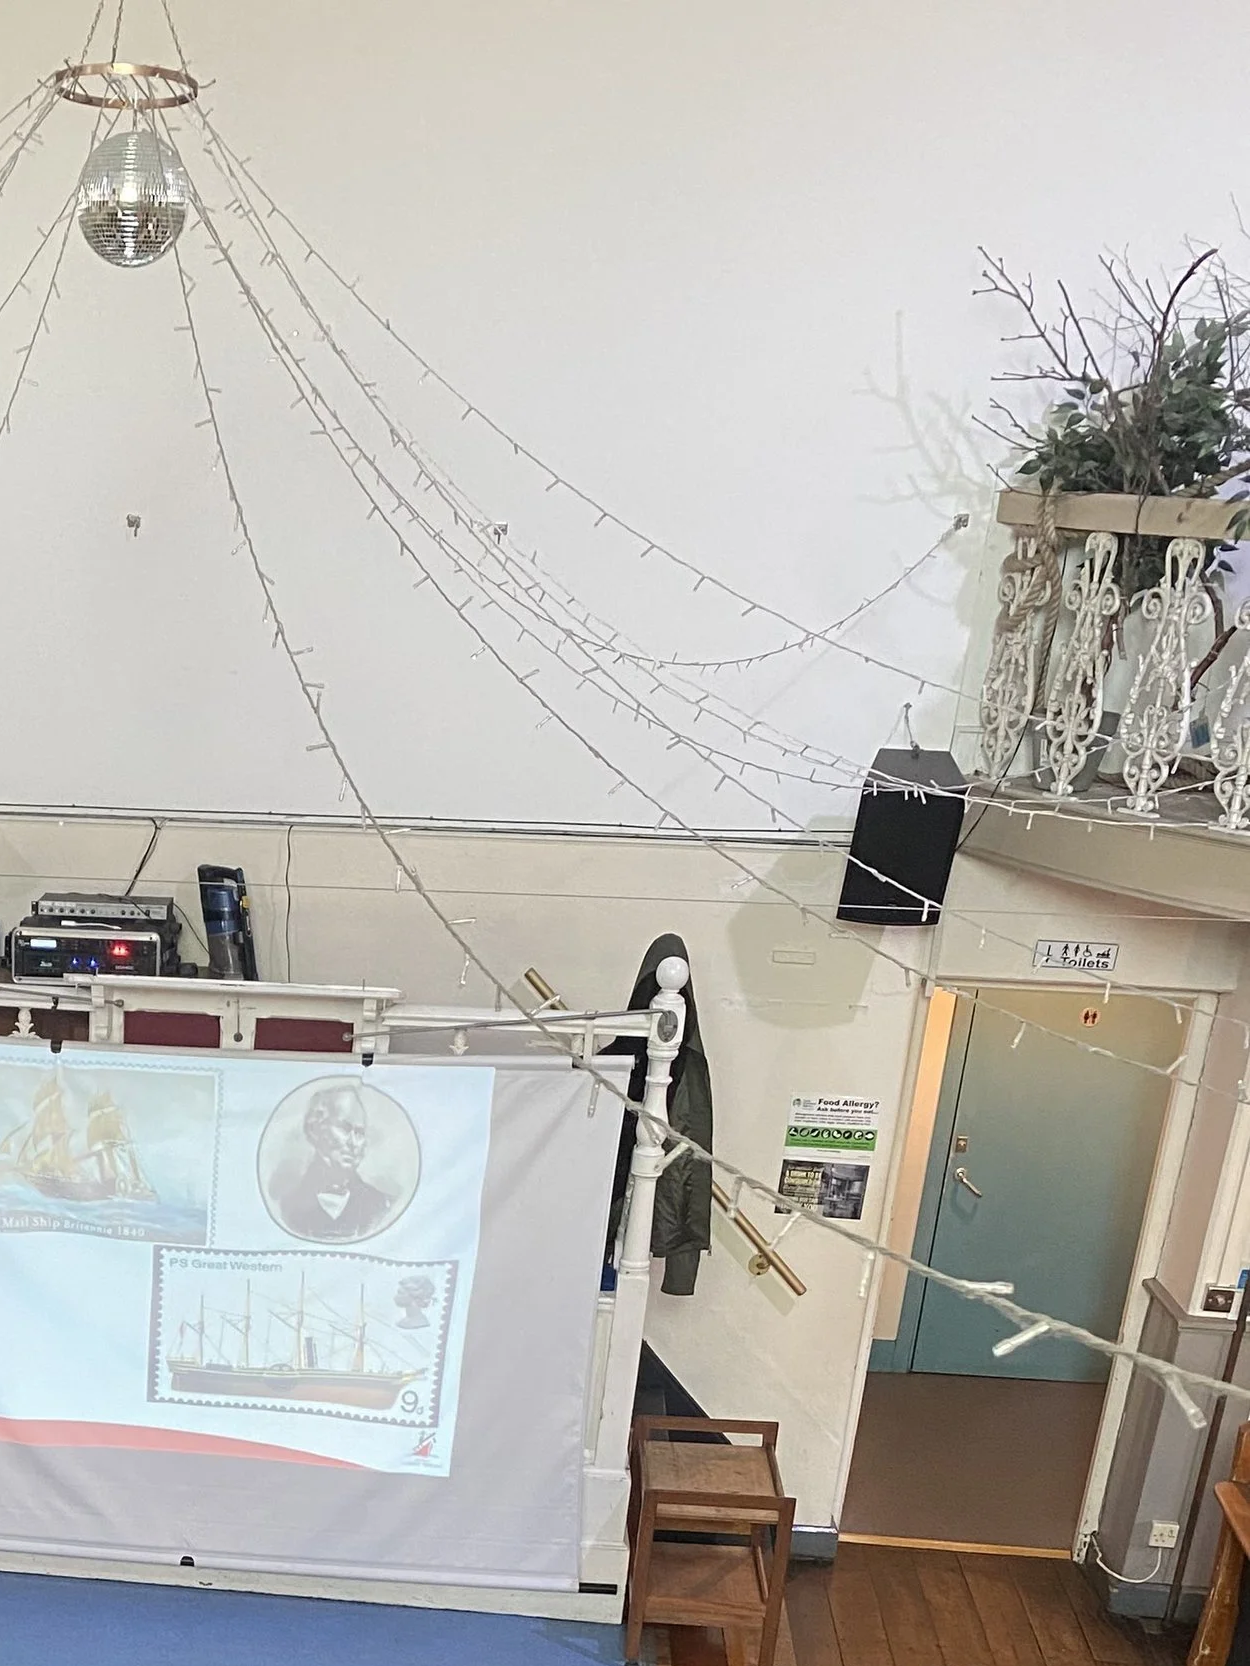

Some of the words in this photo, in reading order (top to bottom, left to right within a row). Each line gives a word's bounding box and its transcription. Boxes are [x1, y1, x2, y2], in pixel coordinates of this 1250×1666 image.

[1060, 956, 1109, 969] Toilets
[818, 1098, 840, 1106] Food
[842, 1100, 880, 1109] Allergy?
[2, 1216, 30, 1228] Mail
[33, 1217, 60, 1230] Ship
[117, 1226, 145, 1237] 1840
[169, 1257, 188, 1268] PS
[191, 1258, 228, 1270] Great
[230, 1260, 283, 1272] Western
